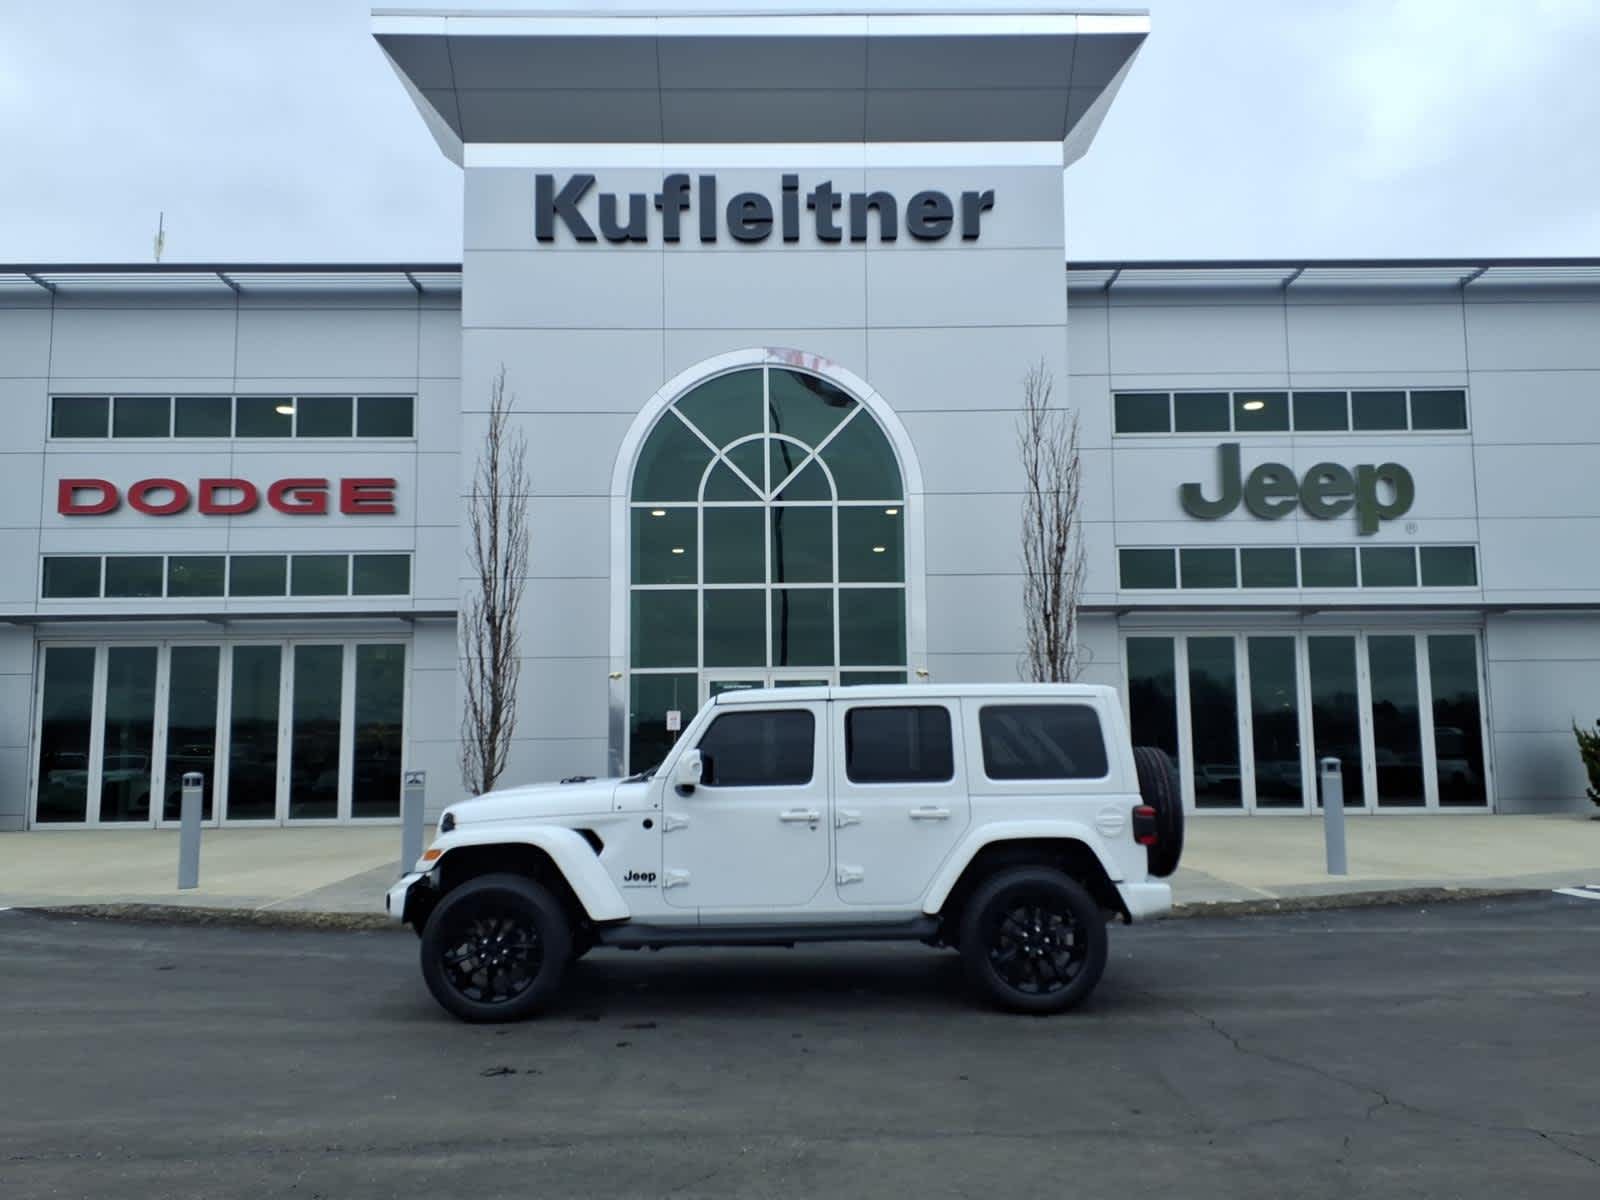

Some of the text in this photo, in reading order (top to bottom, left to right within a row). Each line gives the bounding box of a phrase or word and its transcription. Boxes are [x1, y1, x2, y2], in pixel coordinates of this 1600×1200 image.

[534, 173, 995, 243] Kufleitner
[57, 477, 397, 516] DODGE
[1180, 442, 1415, 536] Jeep
[623, 869, 657, 883] Jeep
